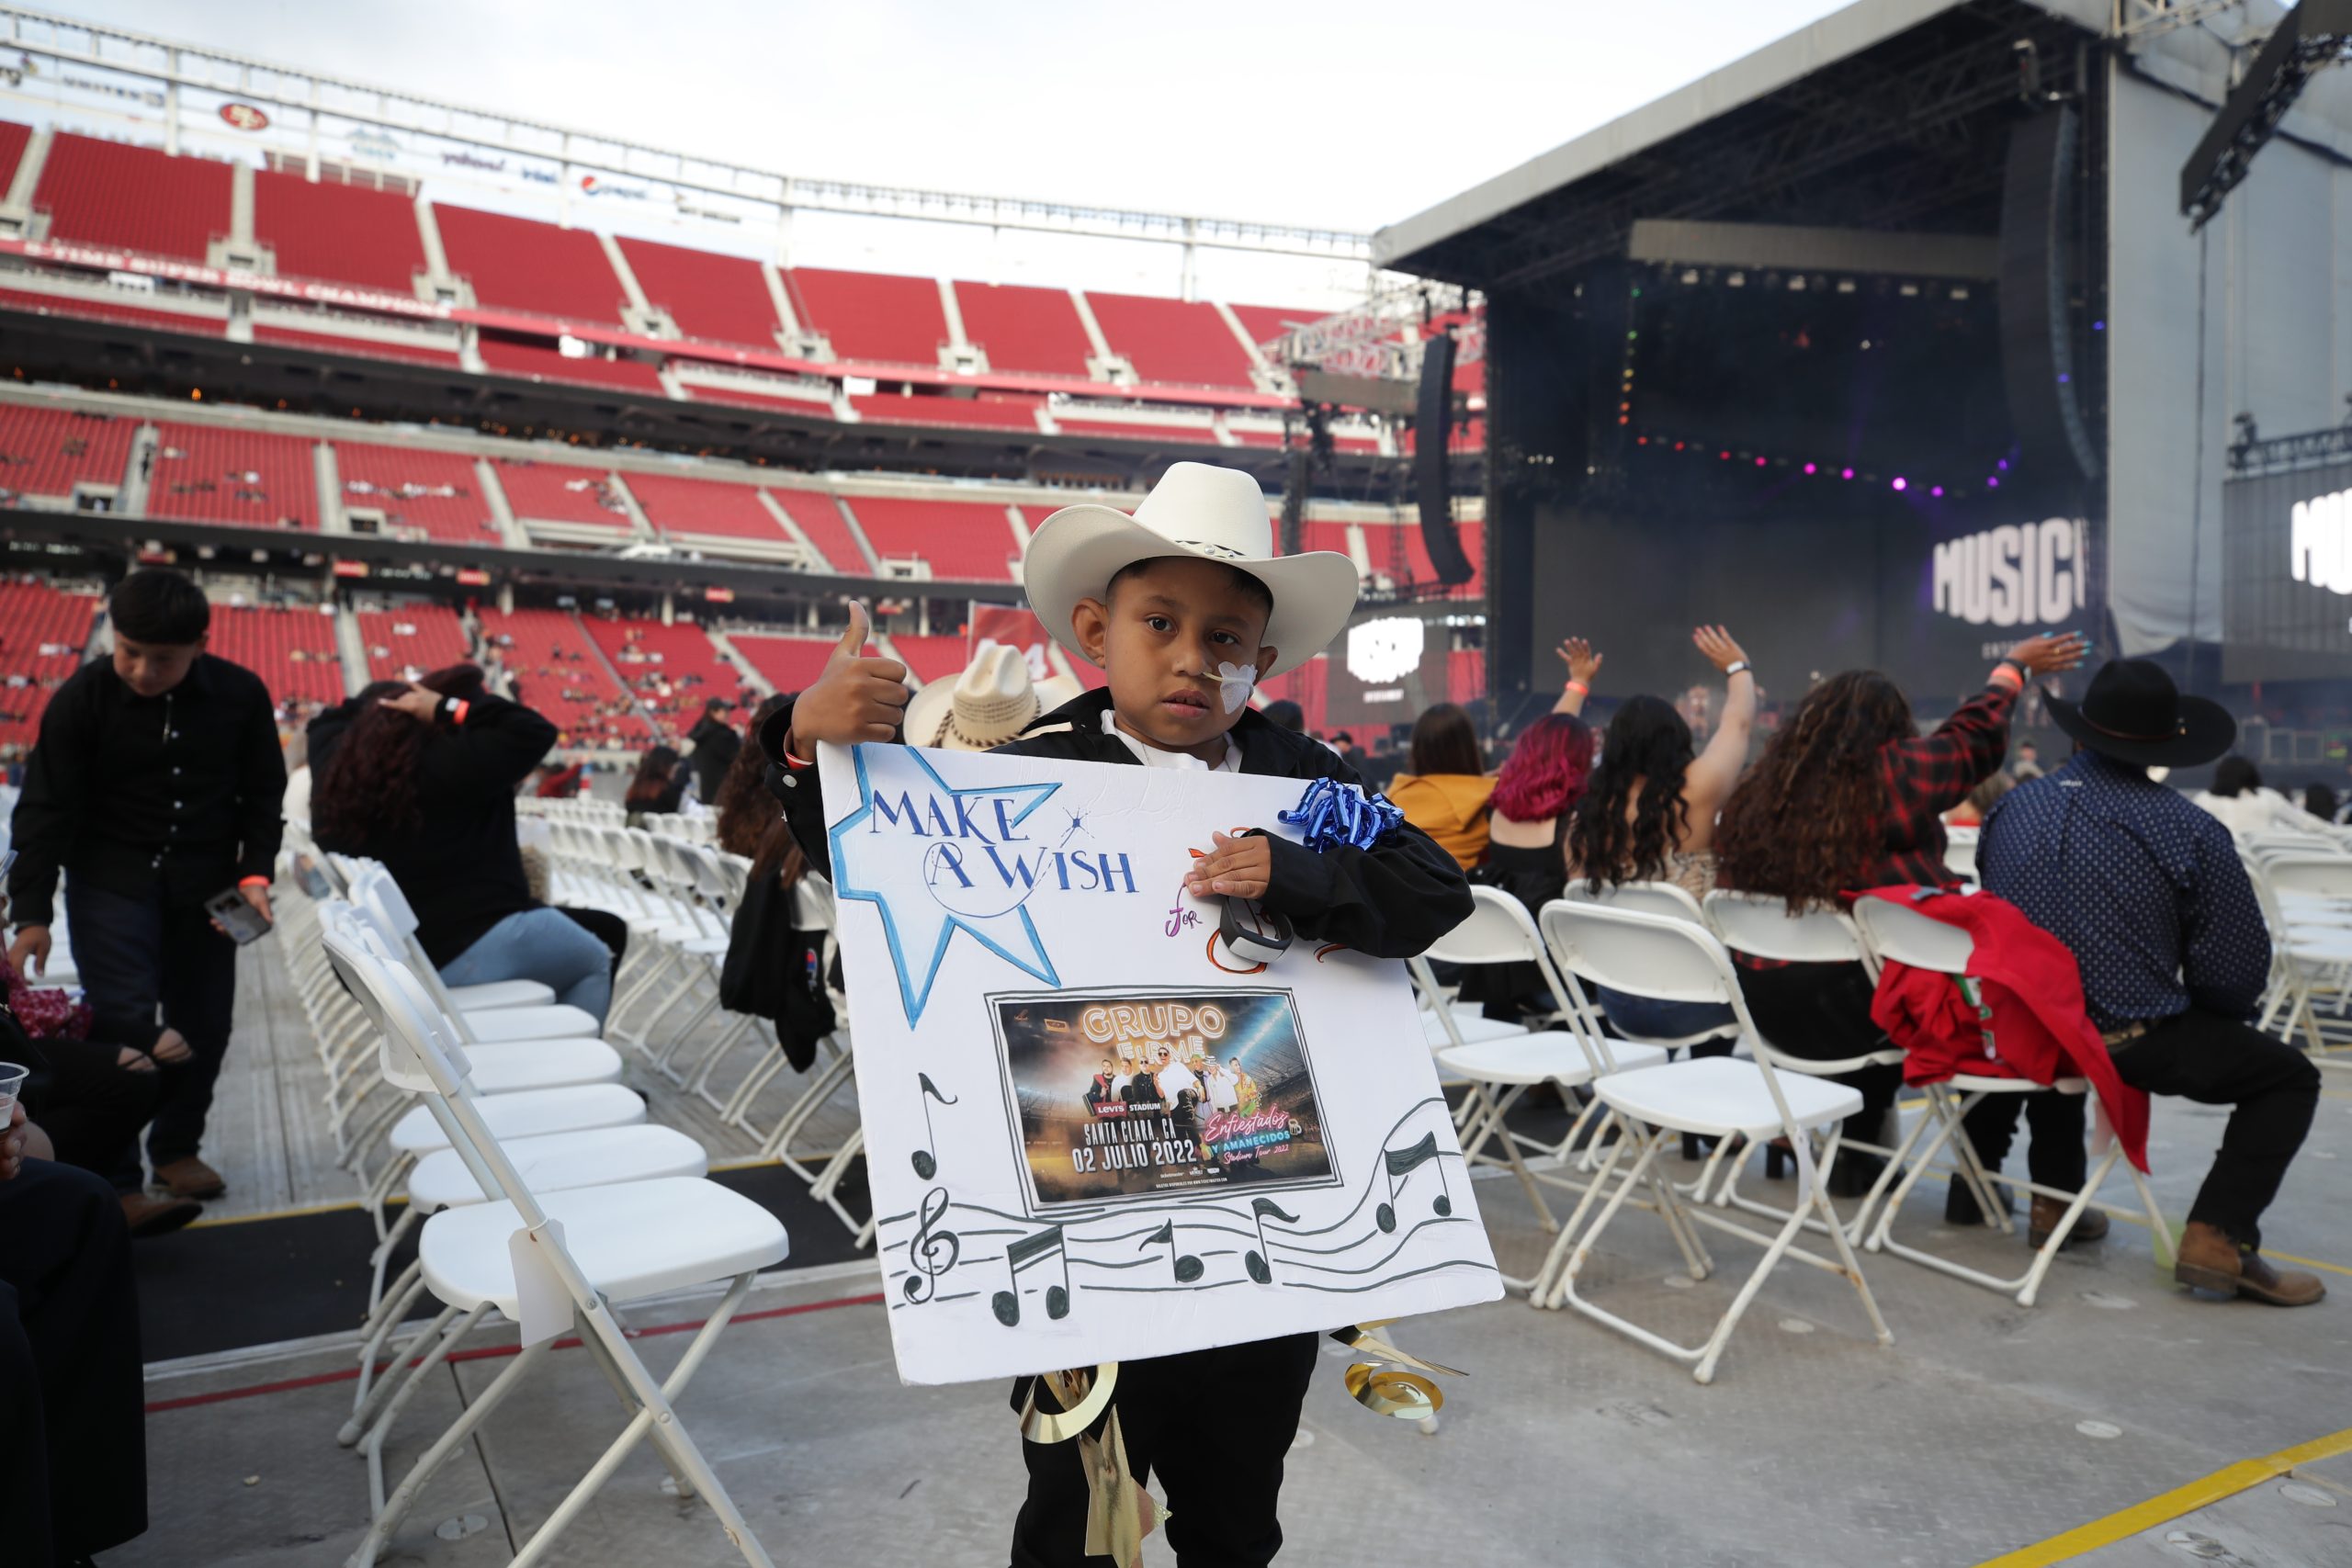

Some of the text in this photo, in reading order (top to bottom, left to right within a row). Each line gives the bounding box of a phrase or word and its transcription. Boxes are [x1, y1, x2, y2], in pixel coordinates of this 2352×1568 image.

[869, 789, 1031, 845] MAKE
[981, 845, 1140, 894] WISH
[1082, 1003, 1227, 1043] GRUPO
[1128, 1102, 1161, 1111] STADIUM
[1083, 1118, 1177, 1146] SANTA CLARA, CA
[1223, 1130, 1291, 1152] AMANECIDOS
[1071, 1139, 1197, 1173] 02 JULIO 2022
[1223, 1150, 1253, 1165] Stadium
[1255, 1145, 1271, 1158] Tour
